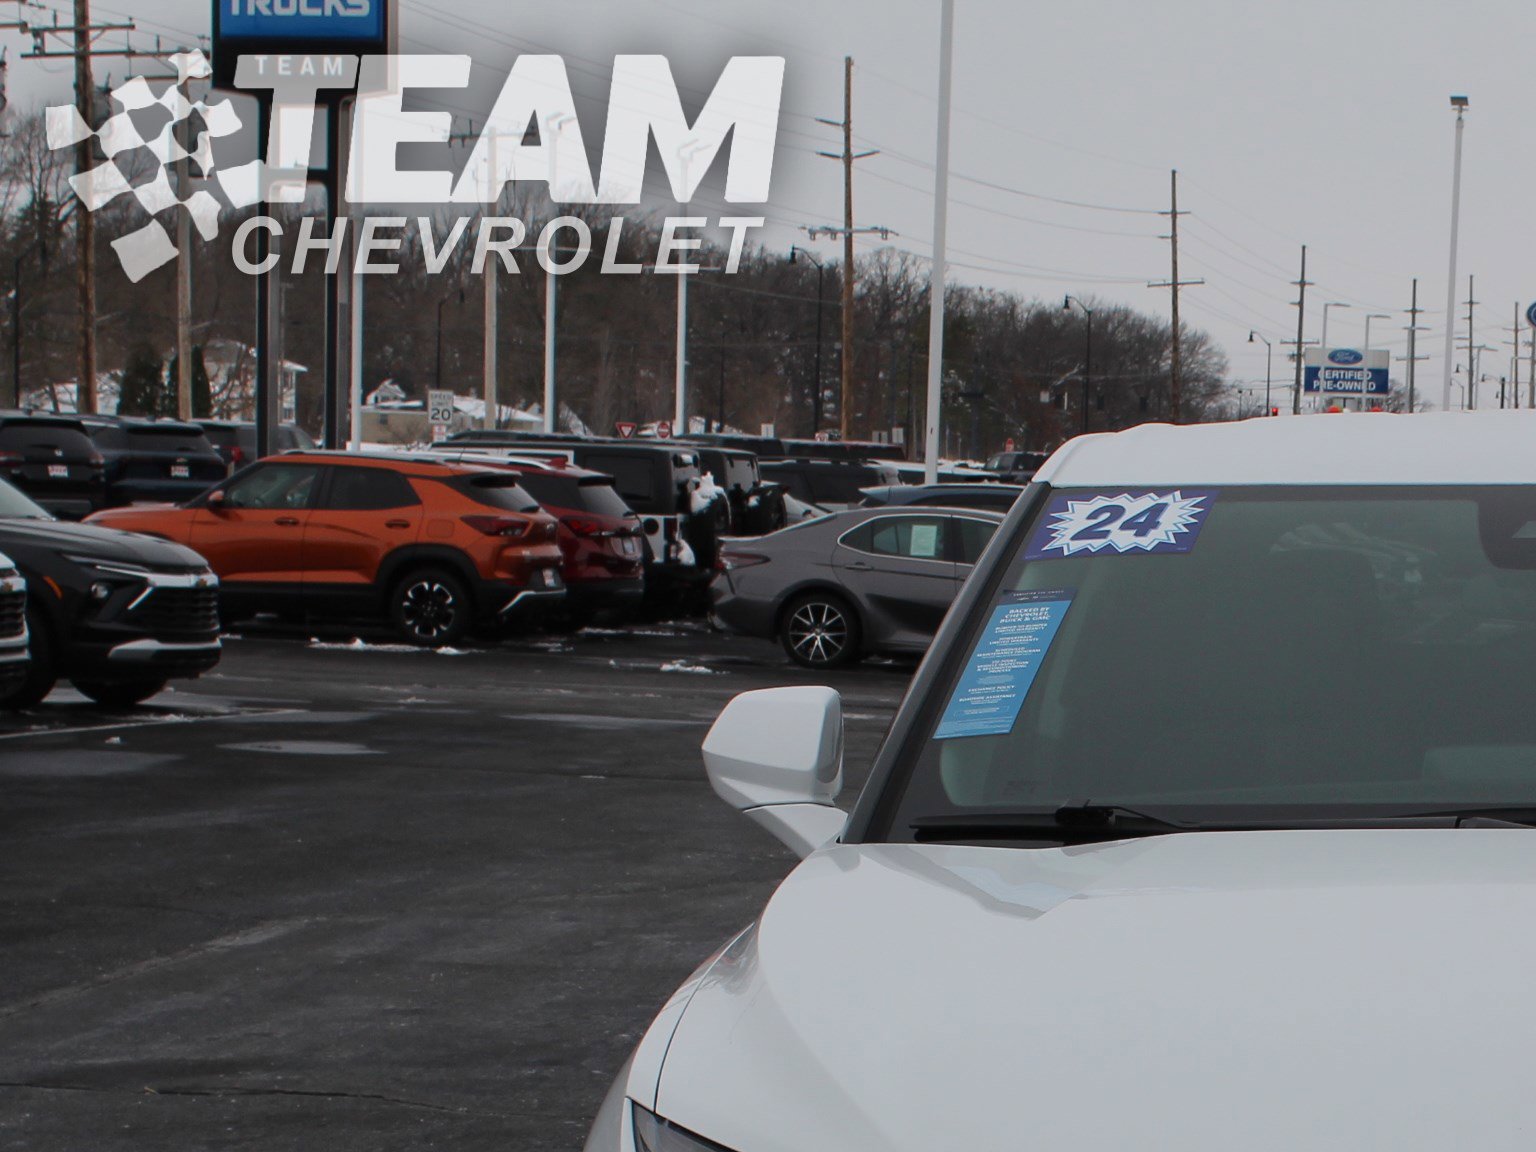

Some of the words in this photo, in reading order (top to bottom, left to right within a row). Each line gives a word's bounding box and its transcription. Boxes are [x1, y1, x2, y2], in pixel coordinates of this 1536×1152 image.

[254, 56, 343, 76] TEAM
[1313, 380, 1376, 391] PE-OWND
[431, 407, 451, 421] 20
[1069, 502, 1169, 541] 24
